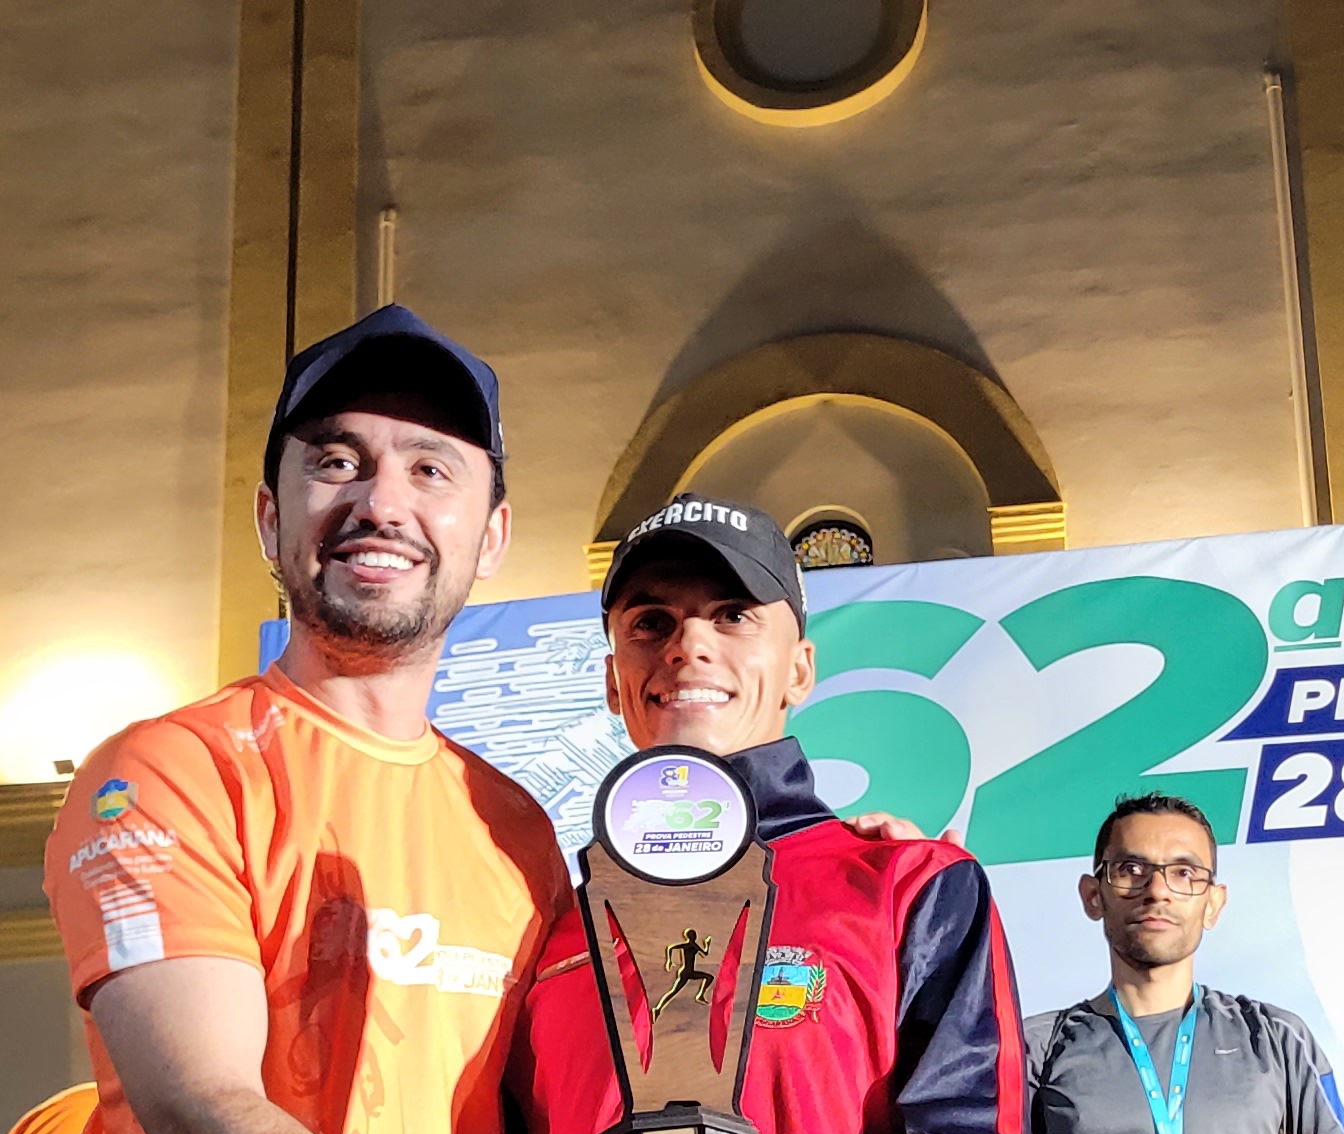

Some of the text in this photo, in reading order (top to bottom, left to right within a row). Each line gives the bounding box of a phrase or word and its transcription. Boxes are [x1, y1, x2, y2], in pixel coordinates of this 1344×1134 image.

[673, 831, 711, 839] PEDESTRE
[69, 829, 178, 874] APUCARANA
[635, 840, 722, 854] 28 de JANEIRO
